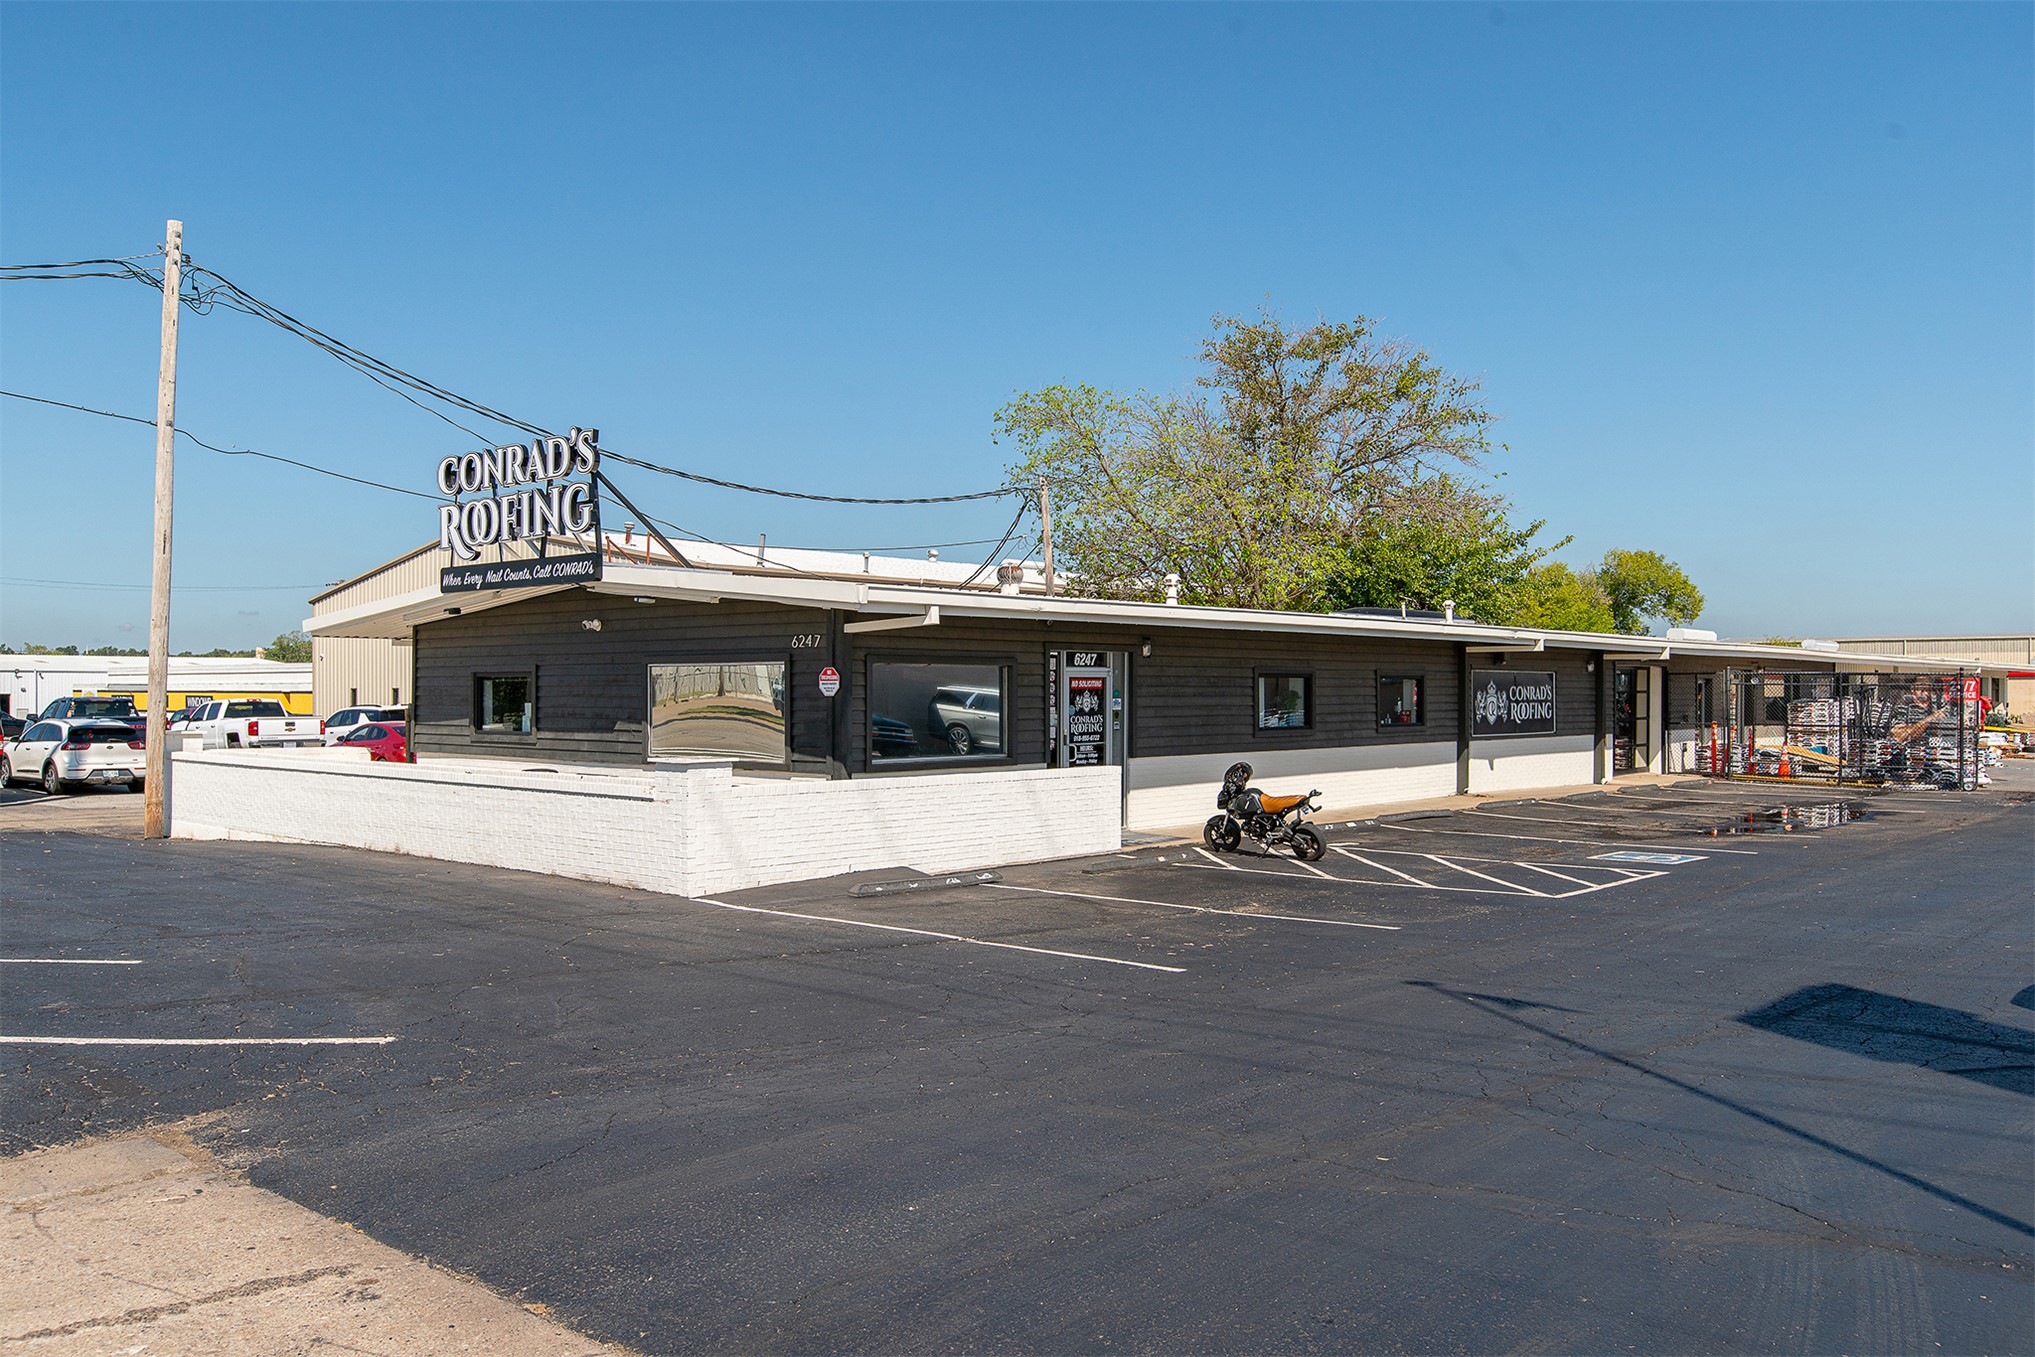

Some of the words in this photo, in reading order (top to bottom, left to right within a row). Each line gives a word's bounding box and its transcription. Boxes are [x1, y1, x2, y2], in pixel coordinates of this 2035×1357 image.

[437, 426, 599, 495] CONRAD'S
[438, 482, 594, 561] ROOFING
[442, 574, 462, 587] When
[463, 572, 483, 589] Every
[485, 567, 502, 583] Nail
[503, 567, 533, 582] Counts,
[532, 564, 552, 578] Call
[791, 634, 821, 649] 6247
[1074, 653, 1097, 666] 6247
[1509, 684, 1552, 701] CONRAD'S
[1948, 691, 1977, 699] SEICE
[1070, 714, 1103, 724] CONRAD'S
[1510, 702, 1552, 724] ROOFING
[1070, 723, 1103, 735] ROOFING
